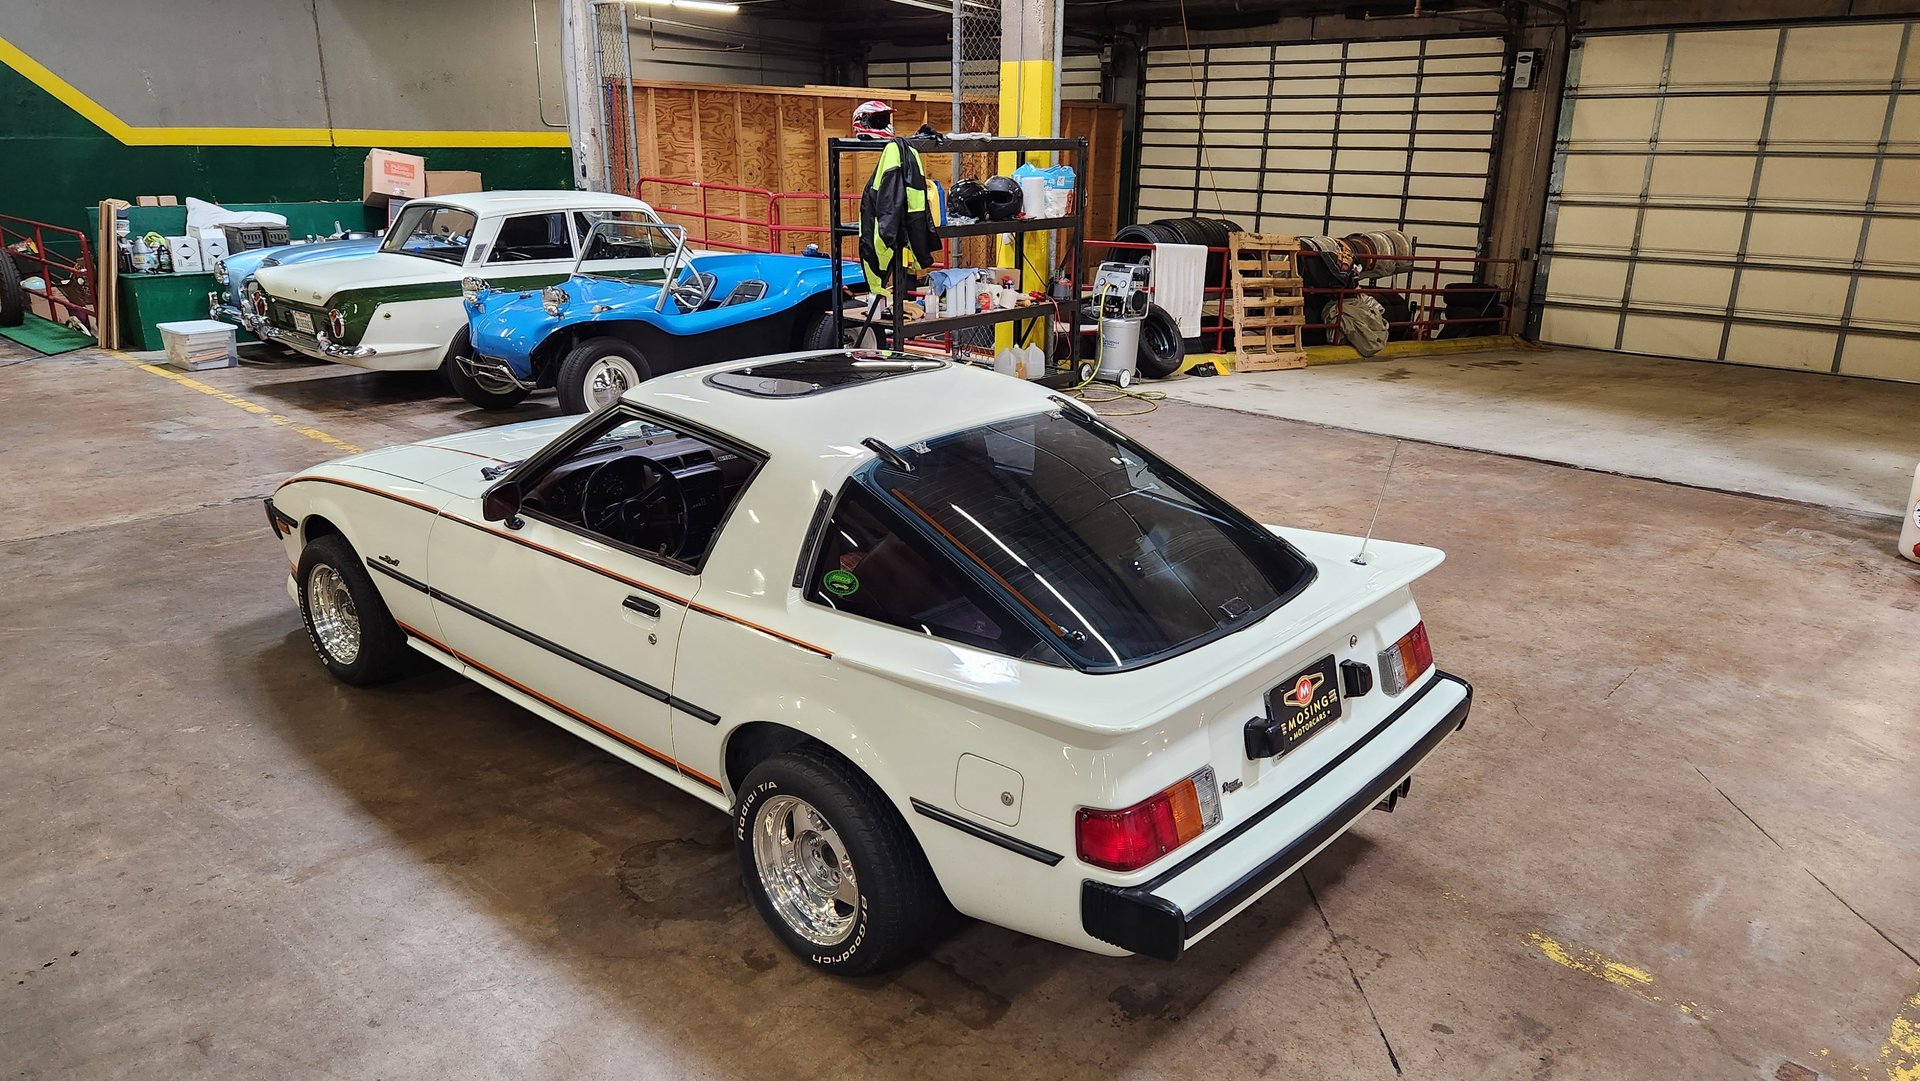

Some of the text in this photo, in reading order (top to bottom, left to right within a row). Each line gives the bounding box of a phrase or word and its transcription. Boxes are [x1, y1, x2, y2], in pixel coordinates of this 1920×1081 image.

[1300, 684, 1309, 698] M
[1288, 695, 1329, 732] MOSING
[1293, 710, 1327, 741] MOTORCARS
[737, 780, 778, 841] Radial T/A
